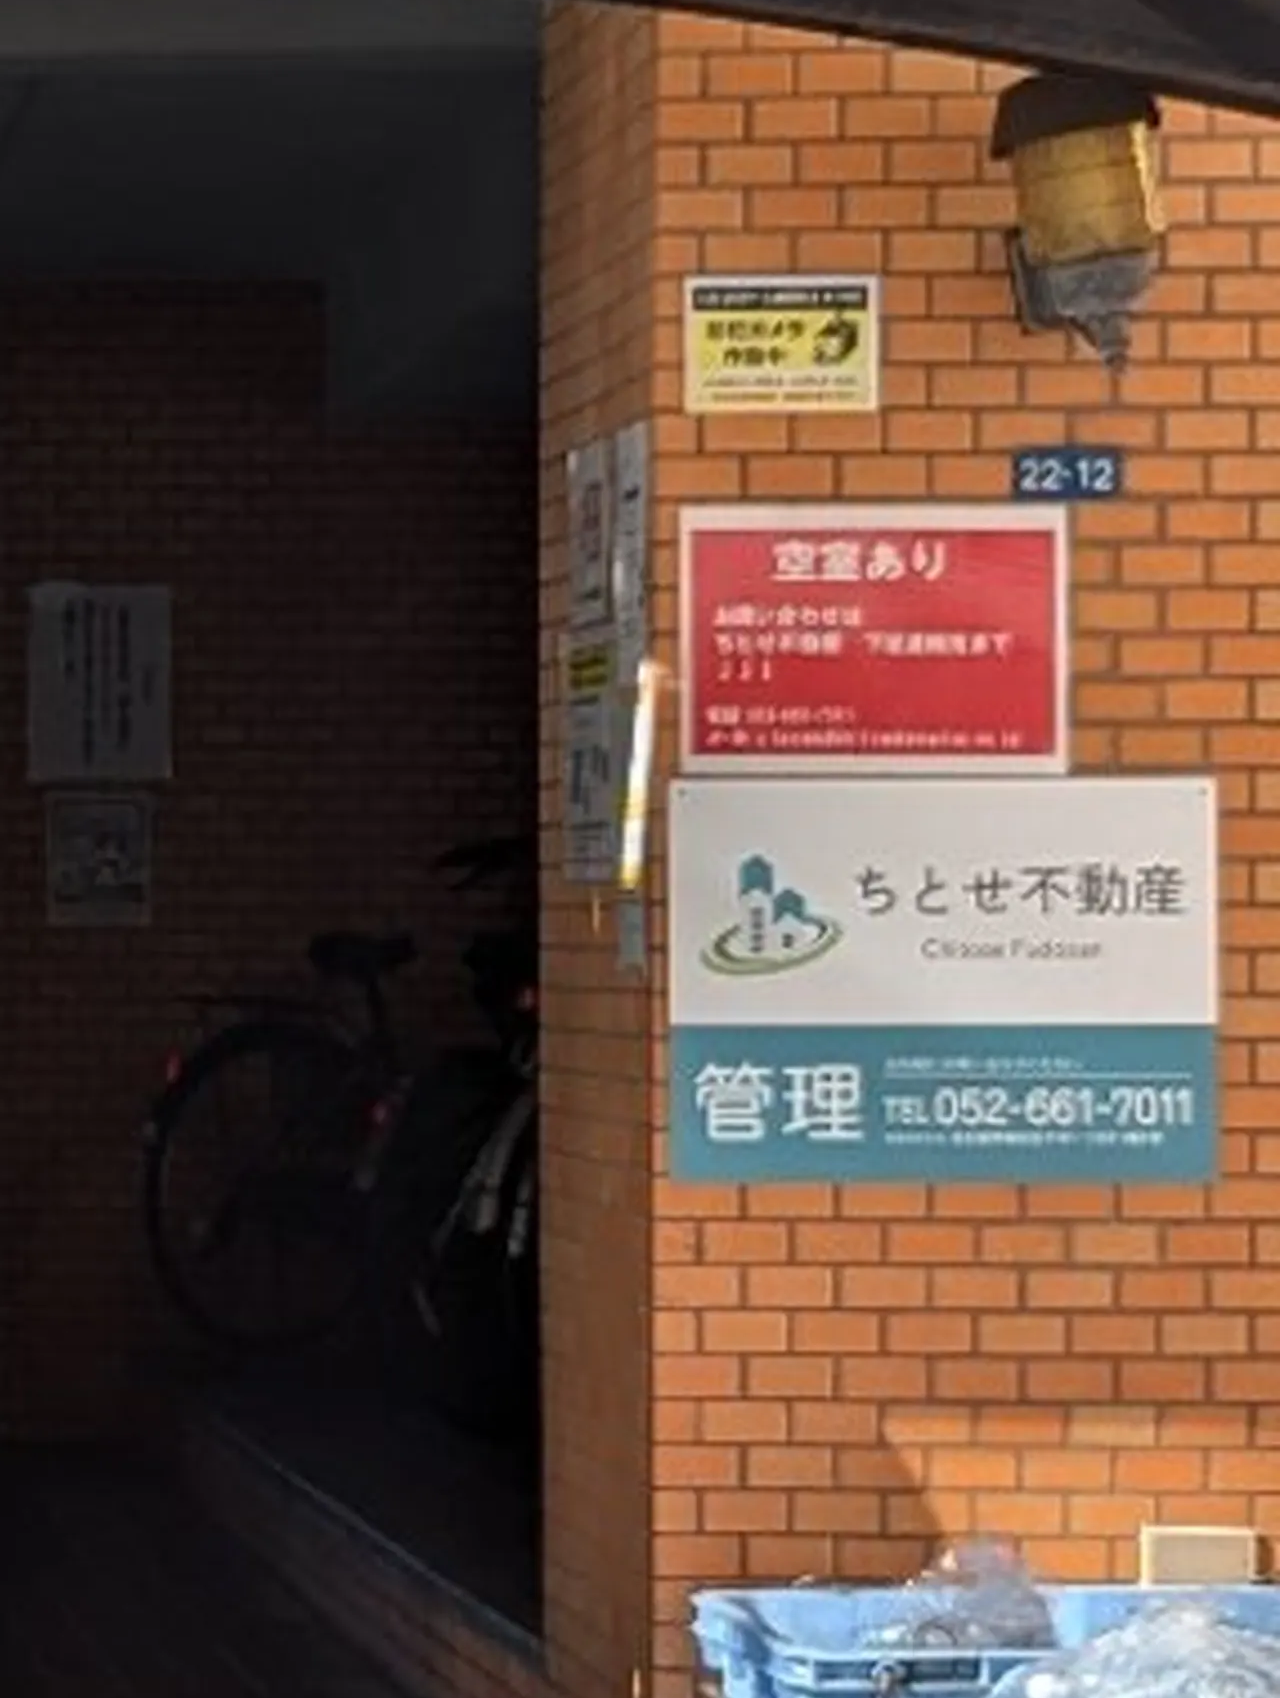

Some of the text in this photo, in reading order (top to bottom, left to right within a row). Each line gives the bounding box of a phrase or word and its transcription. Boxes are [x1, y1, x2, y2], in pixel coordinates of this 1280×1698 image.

[1019, 457, 1115, 492] 22-12
[770, 539, 946, 582] 空室あり
[854, 863, 1188, 917] ちとせ不動産
[692, 1062, 865, 1141] 管理
[881, 1084, 1195, 1127] TEL 052-661-7011
